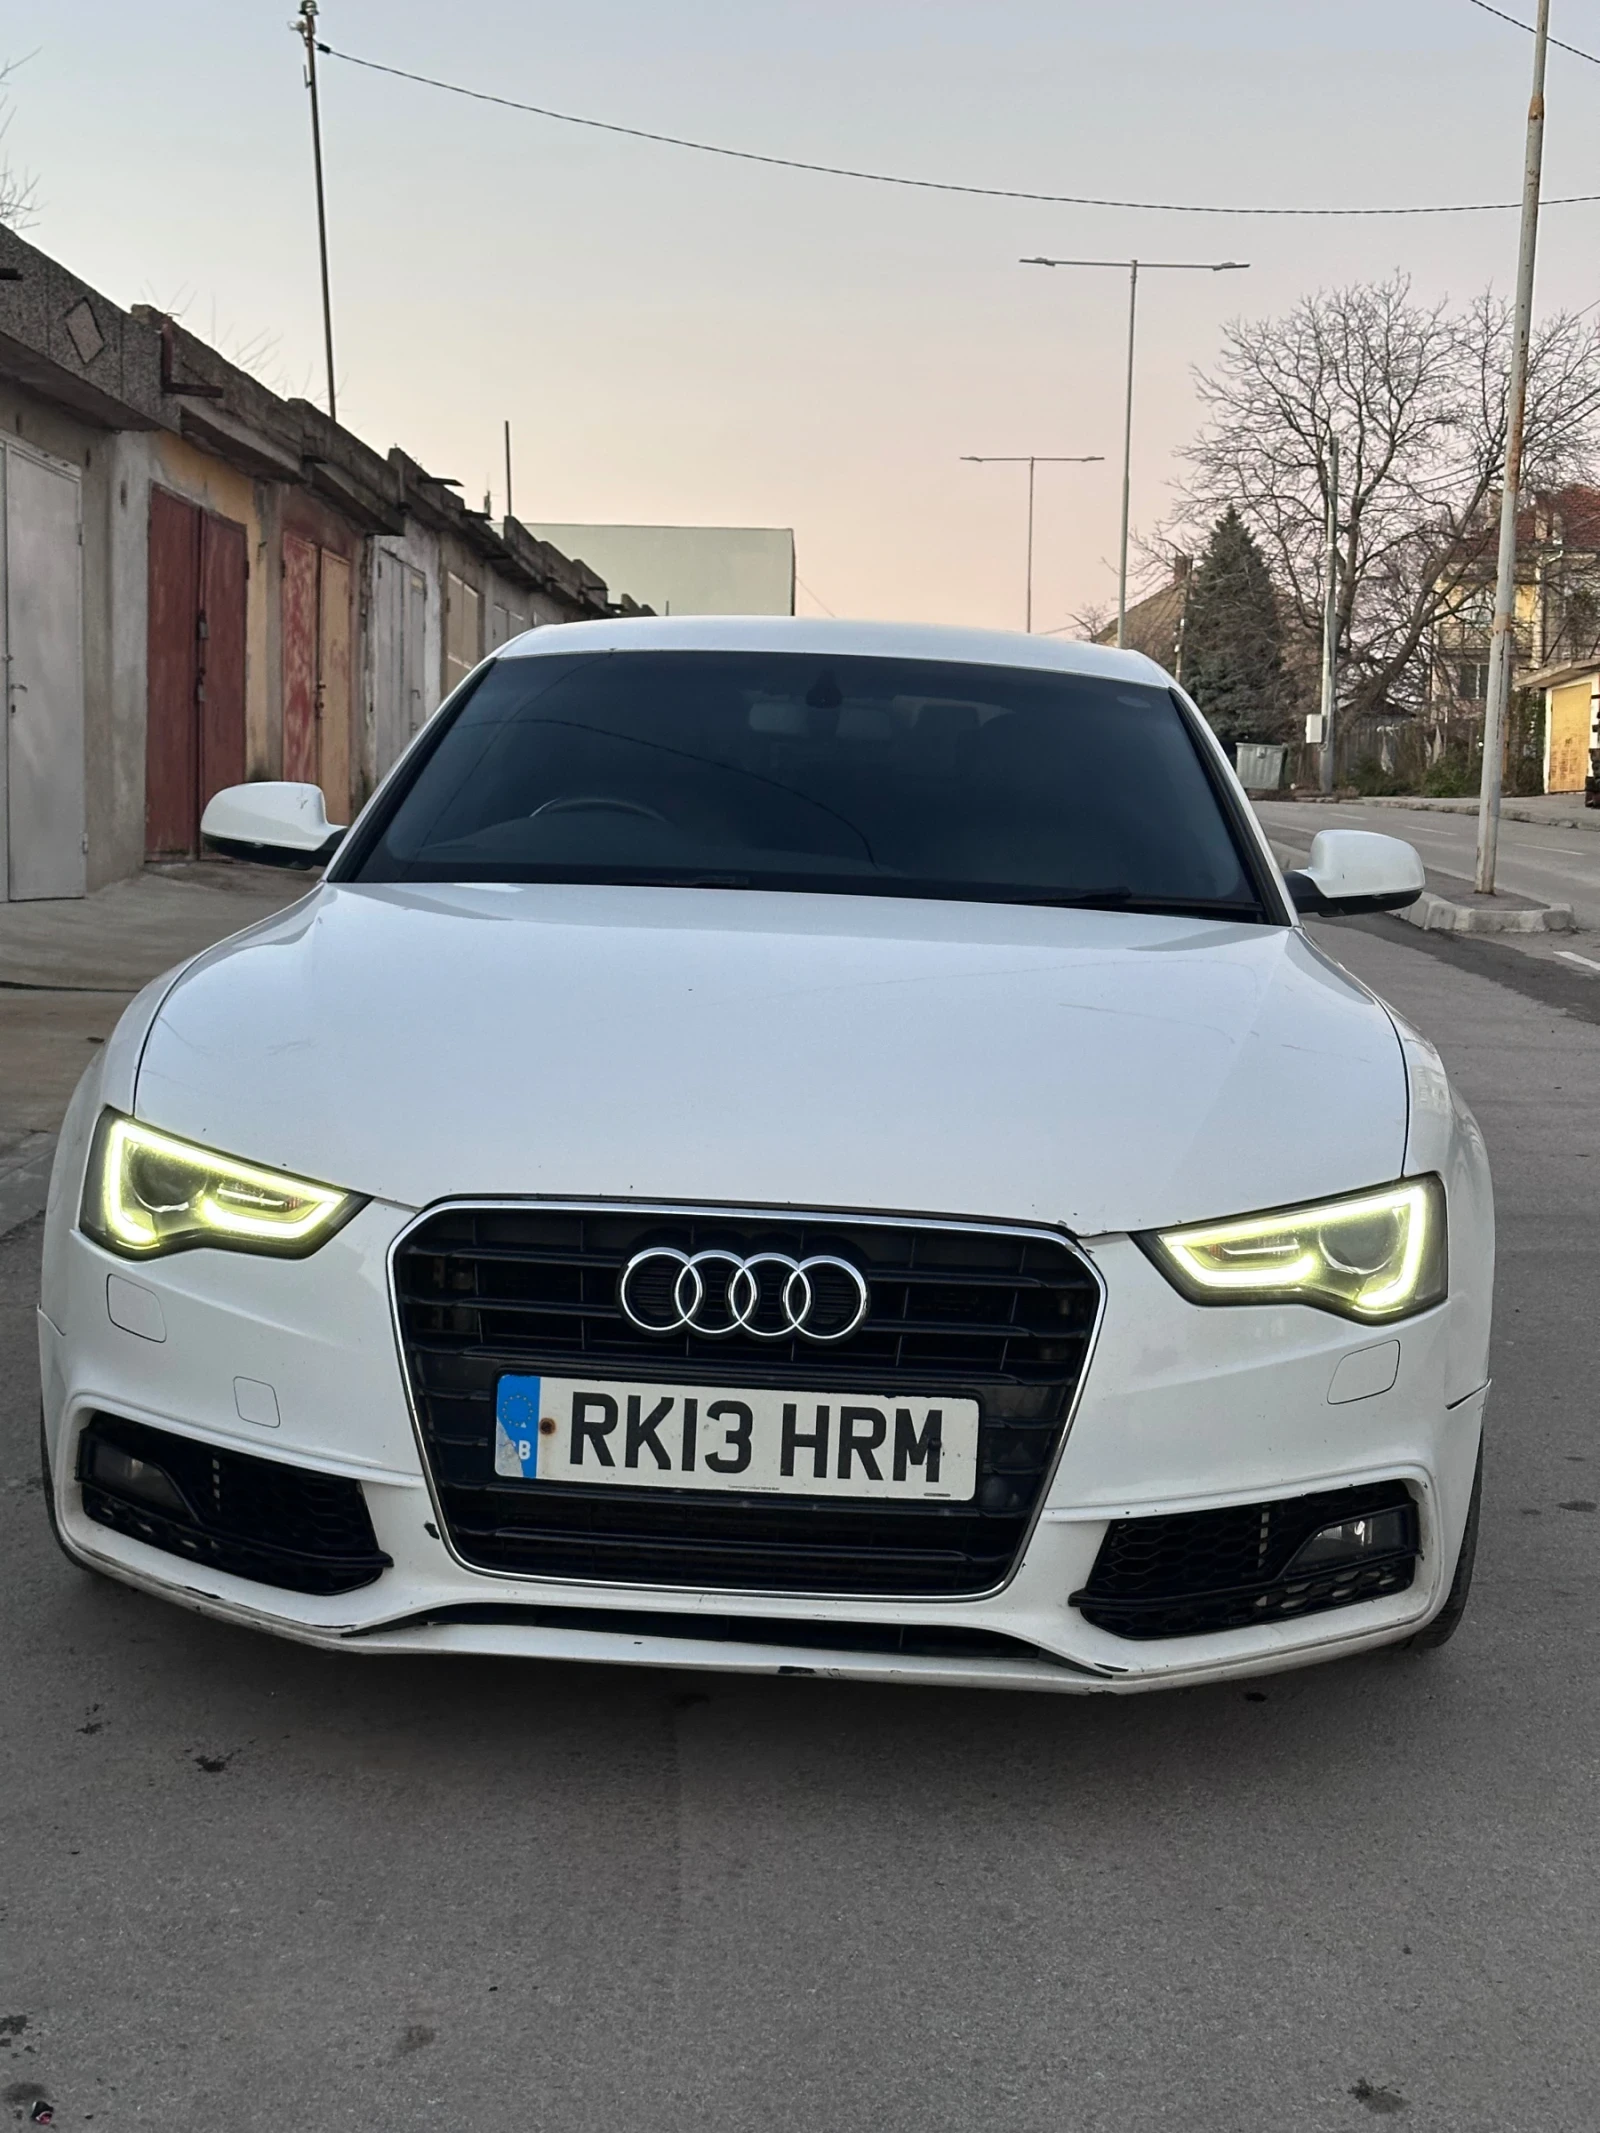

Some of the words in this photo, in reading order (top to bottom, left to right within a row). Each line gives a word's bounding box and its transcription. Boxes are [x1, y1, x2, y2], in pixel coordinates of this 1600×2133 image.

[510, 1439, 532, 1461] B
[569, 1391, 754, 1474] RK13
[779, 1403, 943, 1483] HRM
